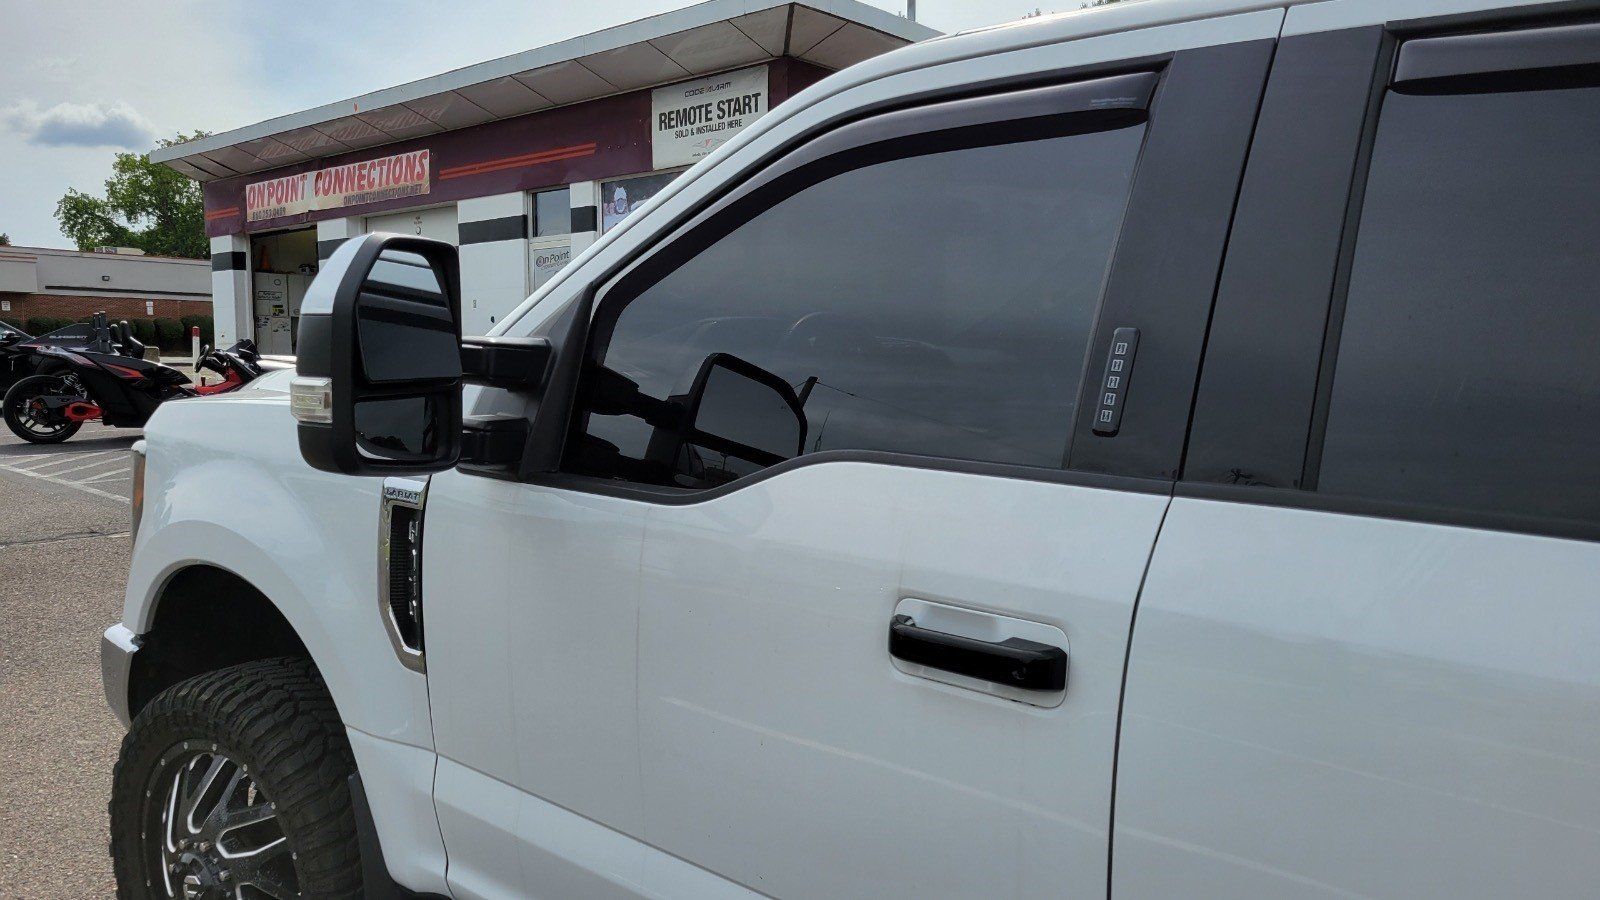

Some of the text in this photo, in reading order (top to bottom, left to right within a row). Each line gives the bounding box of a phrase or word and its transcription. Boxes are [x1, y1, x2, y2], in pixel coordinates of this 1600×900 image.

[684, 87, 704, 98] CODE
[658, 92, 761, 131] REMOTE START
[674, 118, 742, 139] SOLD & INSTALLED HERE
[314, 150, 428, 197] CONNECTIONS
[386, 488, 419, 500] LARIAT
